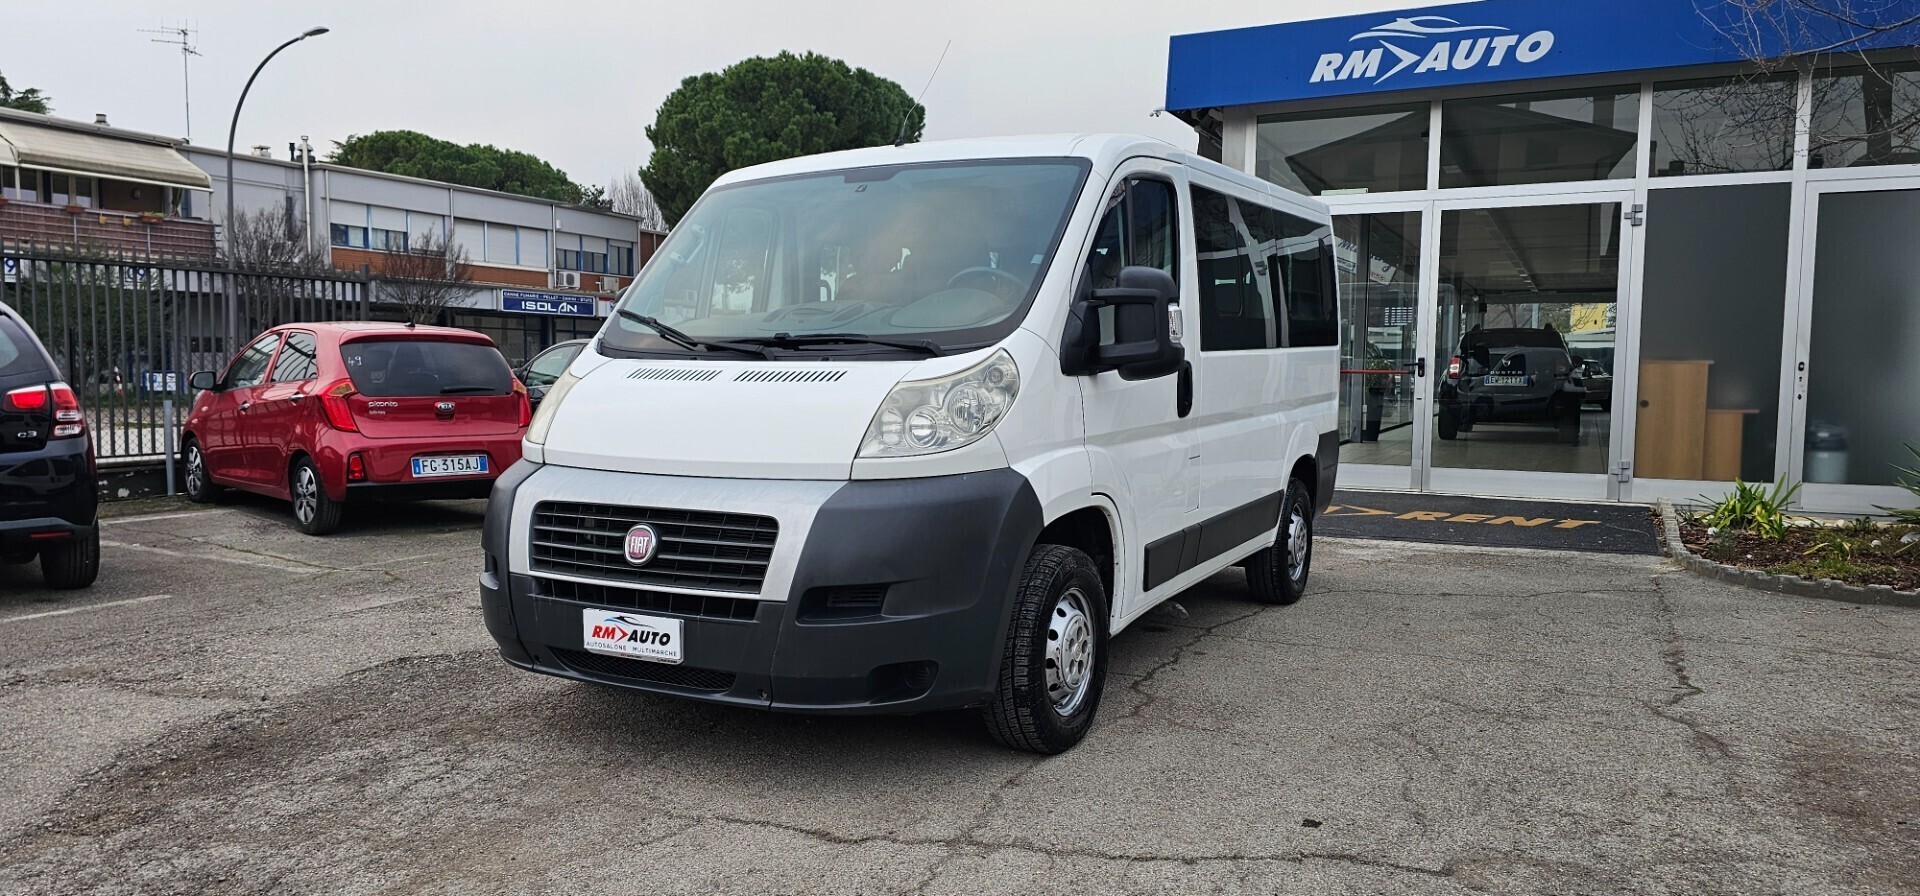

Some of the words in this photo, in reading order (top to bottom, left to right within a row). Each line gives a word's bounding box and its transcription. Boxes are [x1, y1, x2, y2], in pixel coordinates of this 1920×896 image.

[1309, 48, 1384, 83] RM
[1413, 30, 1555, 74] AUTO
[521, 300, 578, 314] ISOLAN
[1394, 510, 1602, 529] RENT
[630, 536, 650, 554] FIAT
[592, 625, 616, 640] RM
[627, 629, 671, 646] AUTO
[586, 641, 627, 652] AUTOSALONE
[632, 646, 677, 657] MULTIMARCHE
